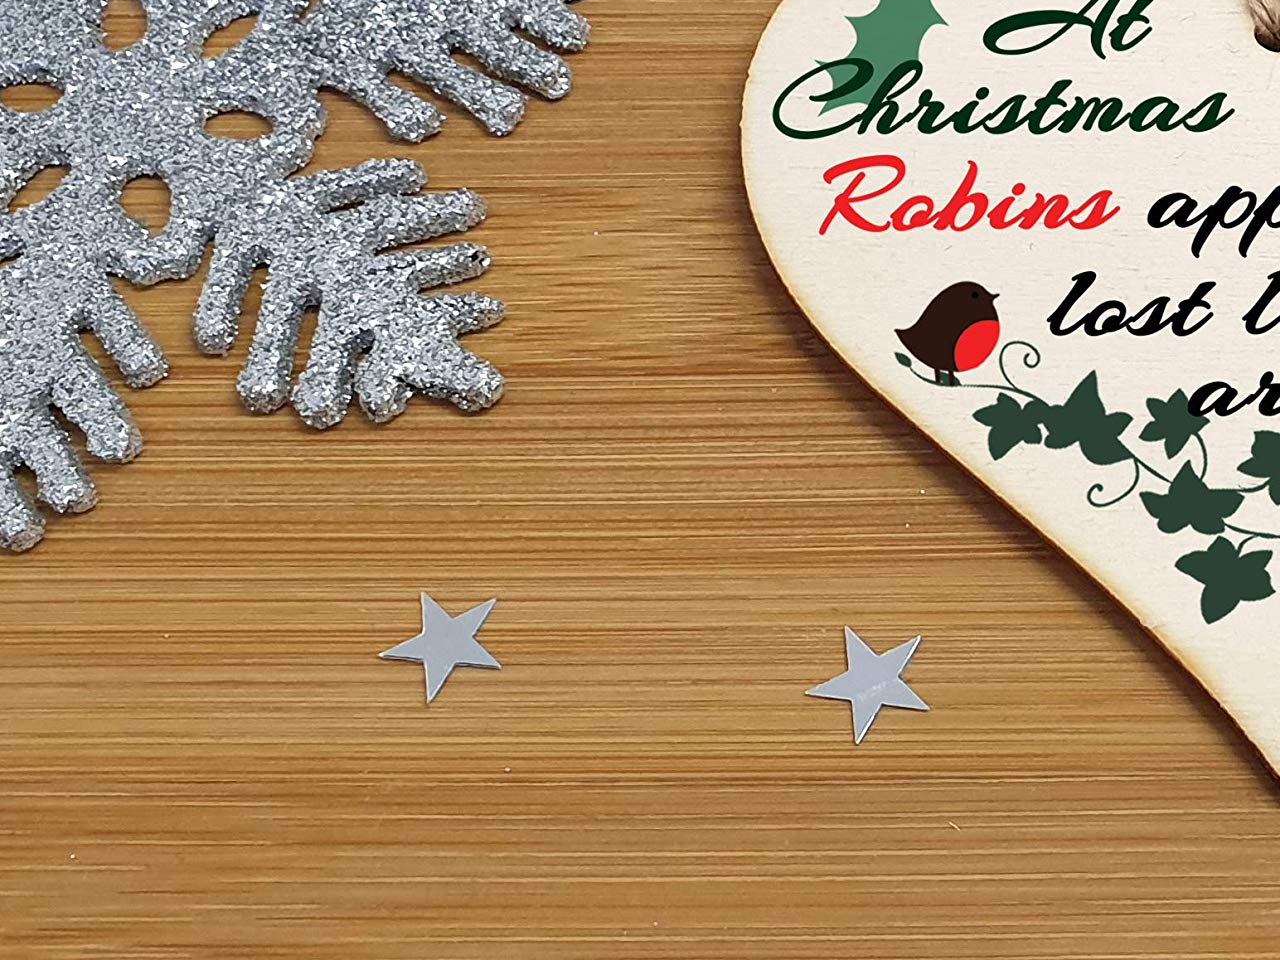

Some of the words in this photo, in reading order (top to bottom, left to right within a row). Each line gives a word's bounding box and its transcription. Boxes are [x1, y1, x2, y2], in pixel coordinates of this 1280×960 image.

[773, 57, 1235, 140] Christmas
[818, 154, 1121, 235] Robins
[1046, 270, 1217, 337] lost
